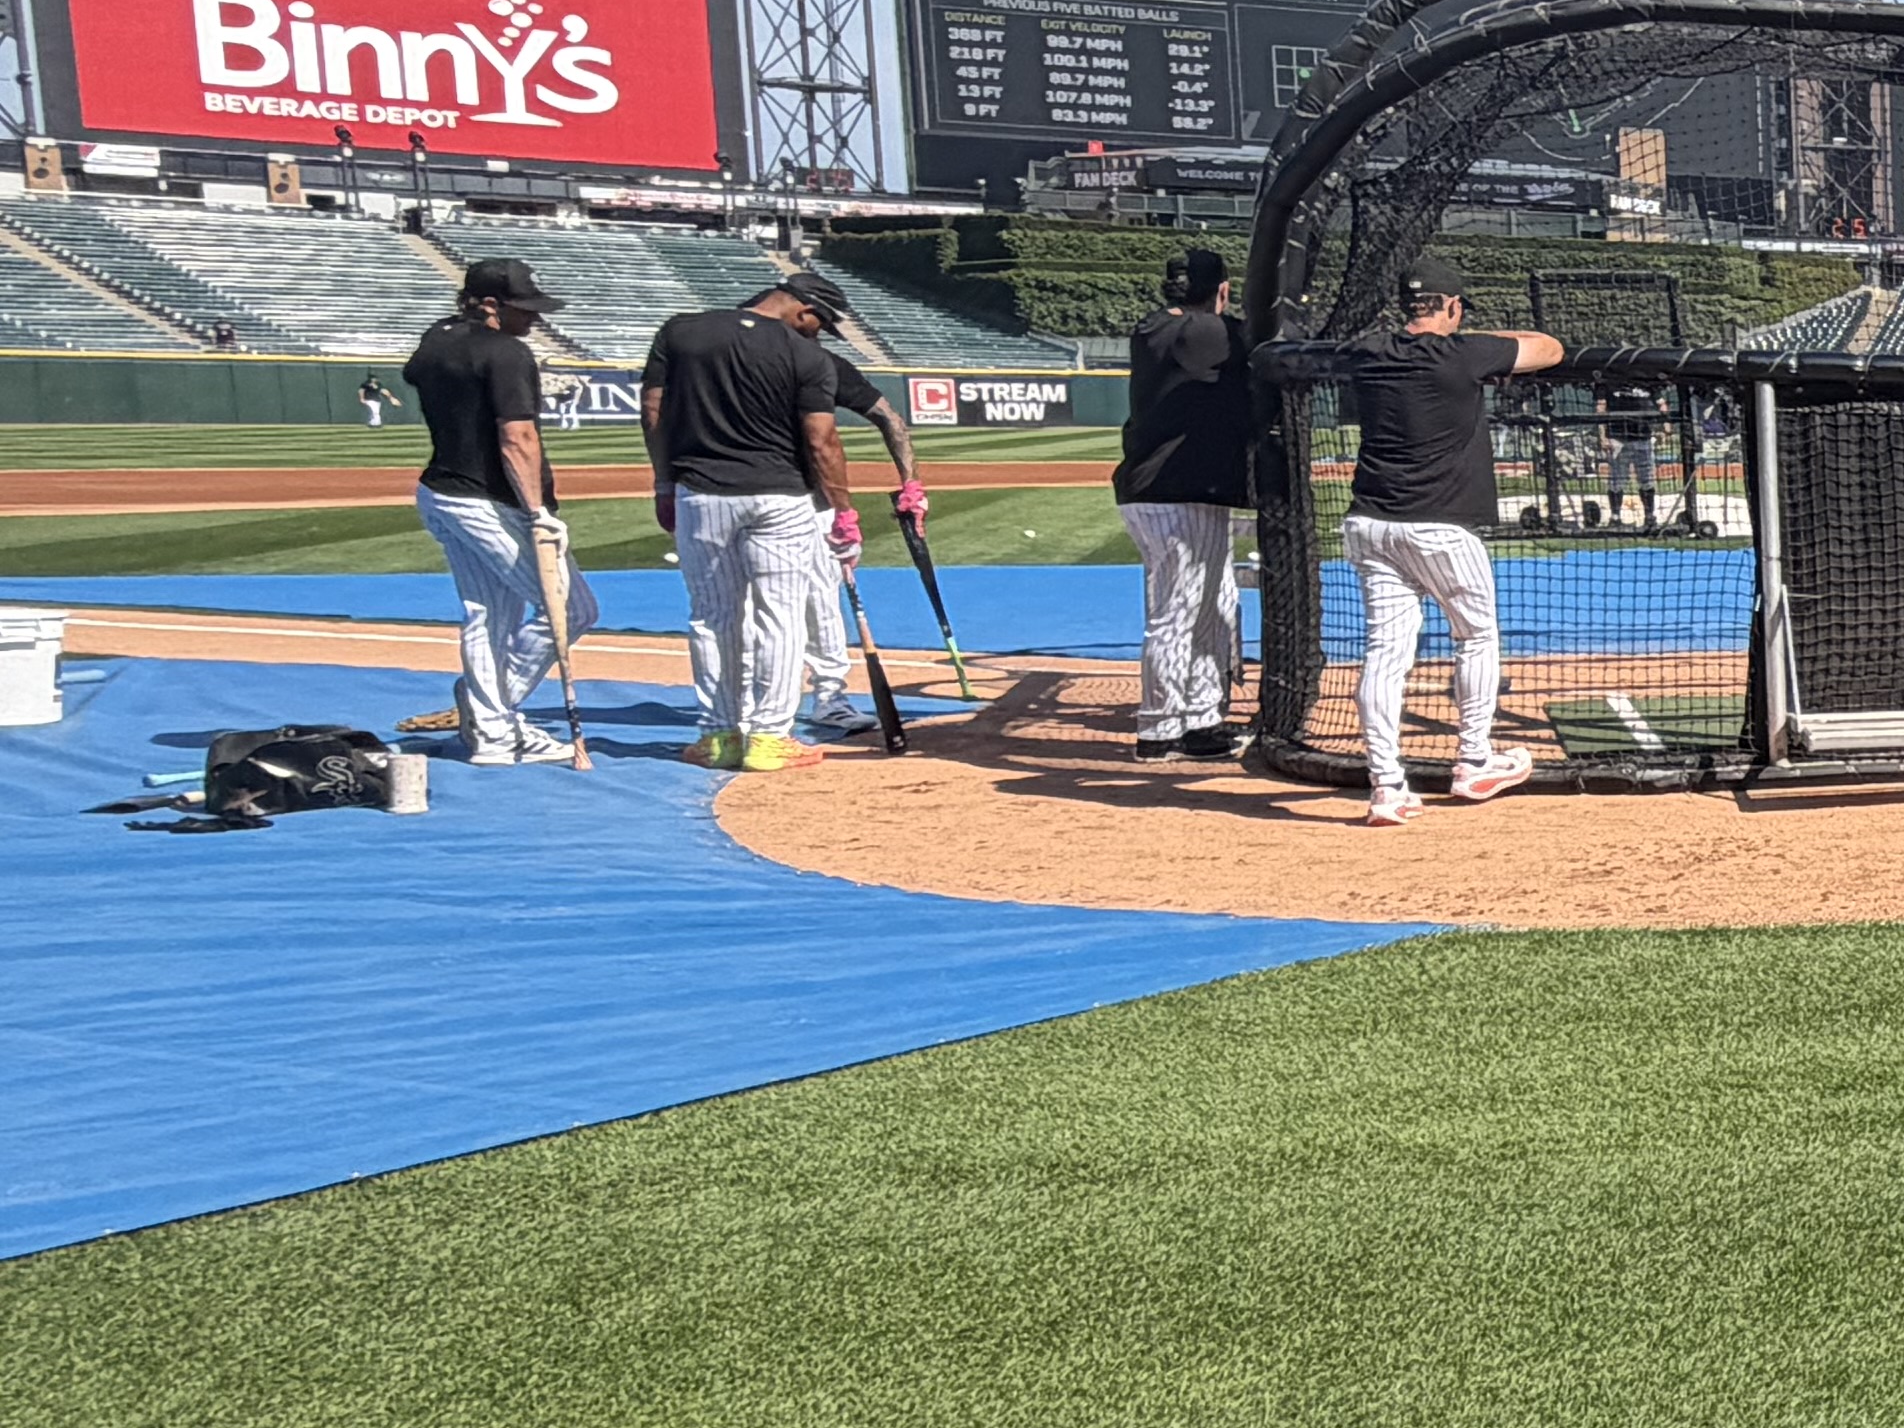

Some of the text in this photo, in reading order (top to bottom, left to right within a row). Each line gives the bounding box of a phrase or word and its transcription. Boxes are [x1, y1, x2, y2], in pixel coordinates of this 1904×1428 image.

[1052, 0, 1081, 14] FIVE
[1083, 4, 1136, 19] BATTED
[1137, 8, 1180, 22] BALLS
[944, 11, 1212, 41] DISTANCE EXIT VELOCITY LAUNCH
[984, 29, 1005, 43] FT
[1086, 37, 1123, 52] MPH
[985, 49, 1006, 62] FT
[1042, 53, 1089, 68] 100.1
[1092, 56, 1130, 71] MPH
[955, 66, 980, 79] 45
[981, 67, 1002, 80] FT
[1088, 74, 1126, 89] MPH
[957, 84, 981, 98] 13
[983, 85, 1003, 99] FT
[1094, 93, 1132, 108] MPH
[203, 91, 461, 130] BEVERAGE DEPOT
[978, 104, 1000, 117] FT
[1091, 111, 1128, 125] MPH
[1074, 171, 1137, 188] FAN DECK
[1176, 168, 1244, 181] WELCOME
[959, 382, 1067, 403] STREAM
[985, 402, 1046, 422] NOW
